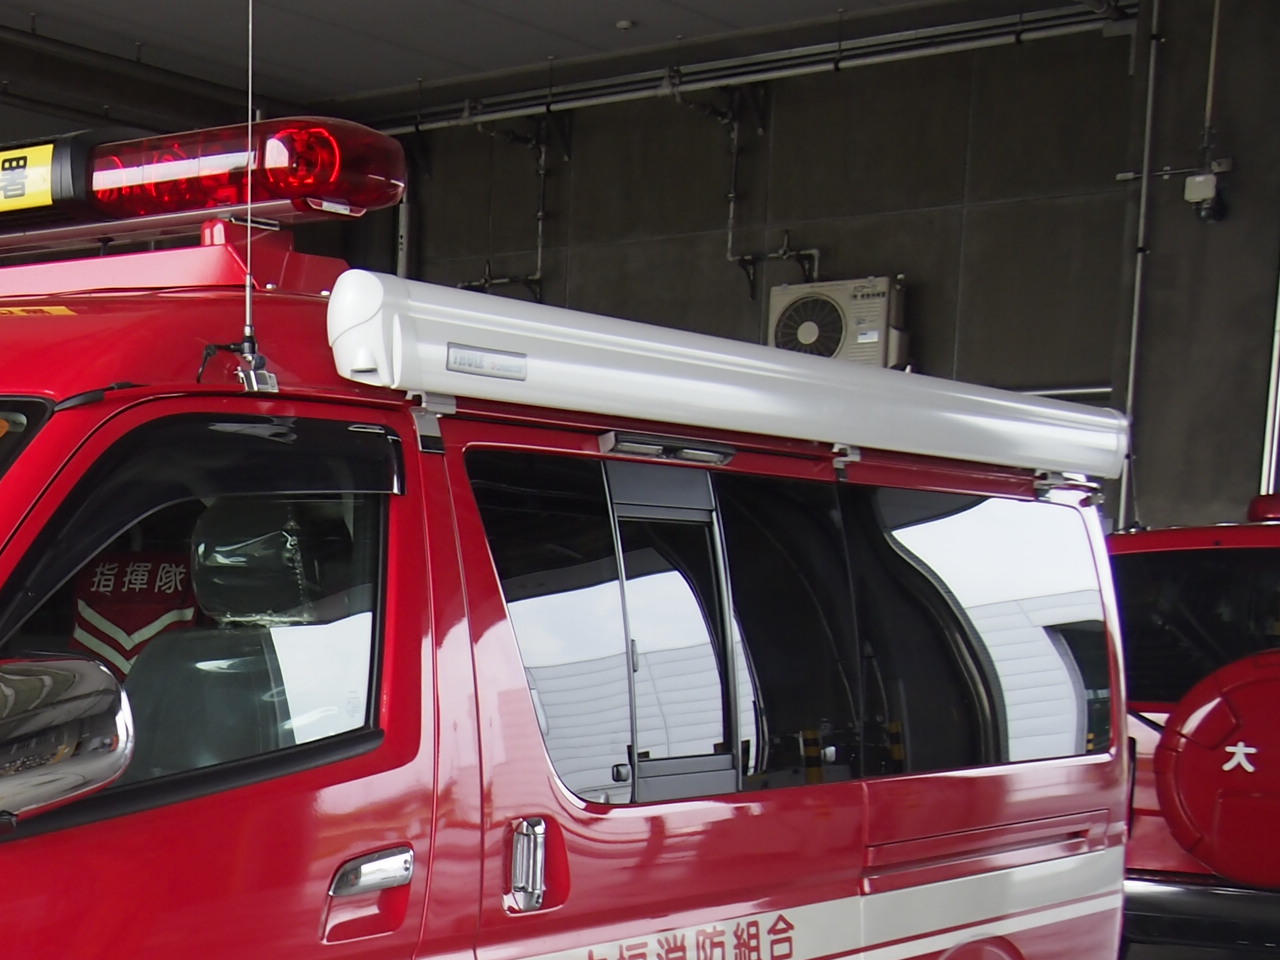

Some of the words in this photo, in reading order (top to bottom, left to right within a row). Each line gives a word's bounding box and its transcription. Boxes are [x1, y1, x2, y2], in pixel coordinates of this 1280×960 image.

[90, 562, 187, 594] 指揮隊
[1222, 741, 1257, 772] 大
